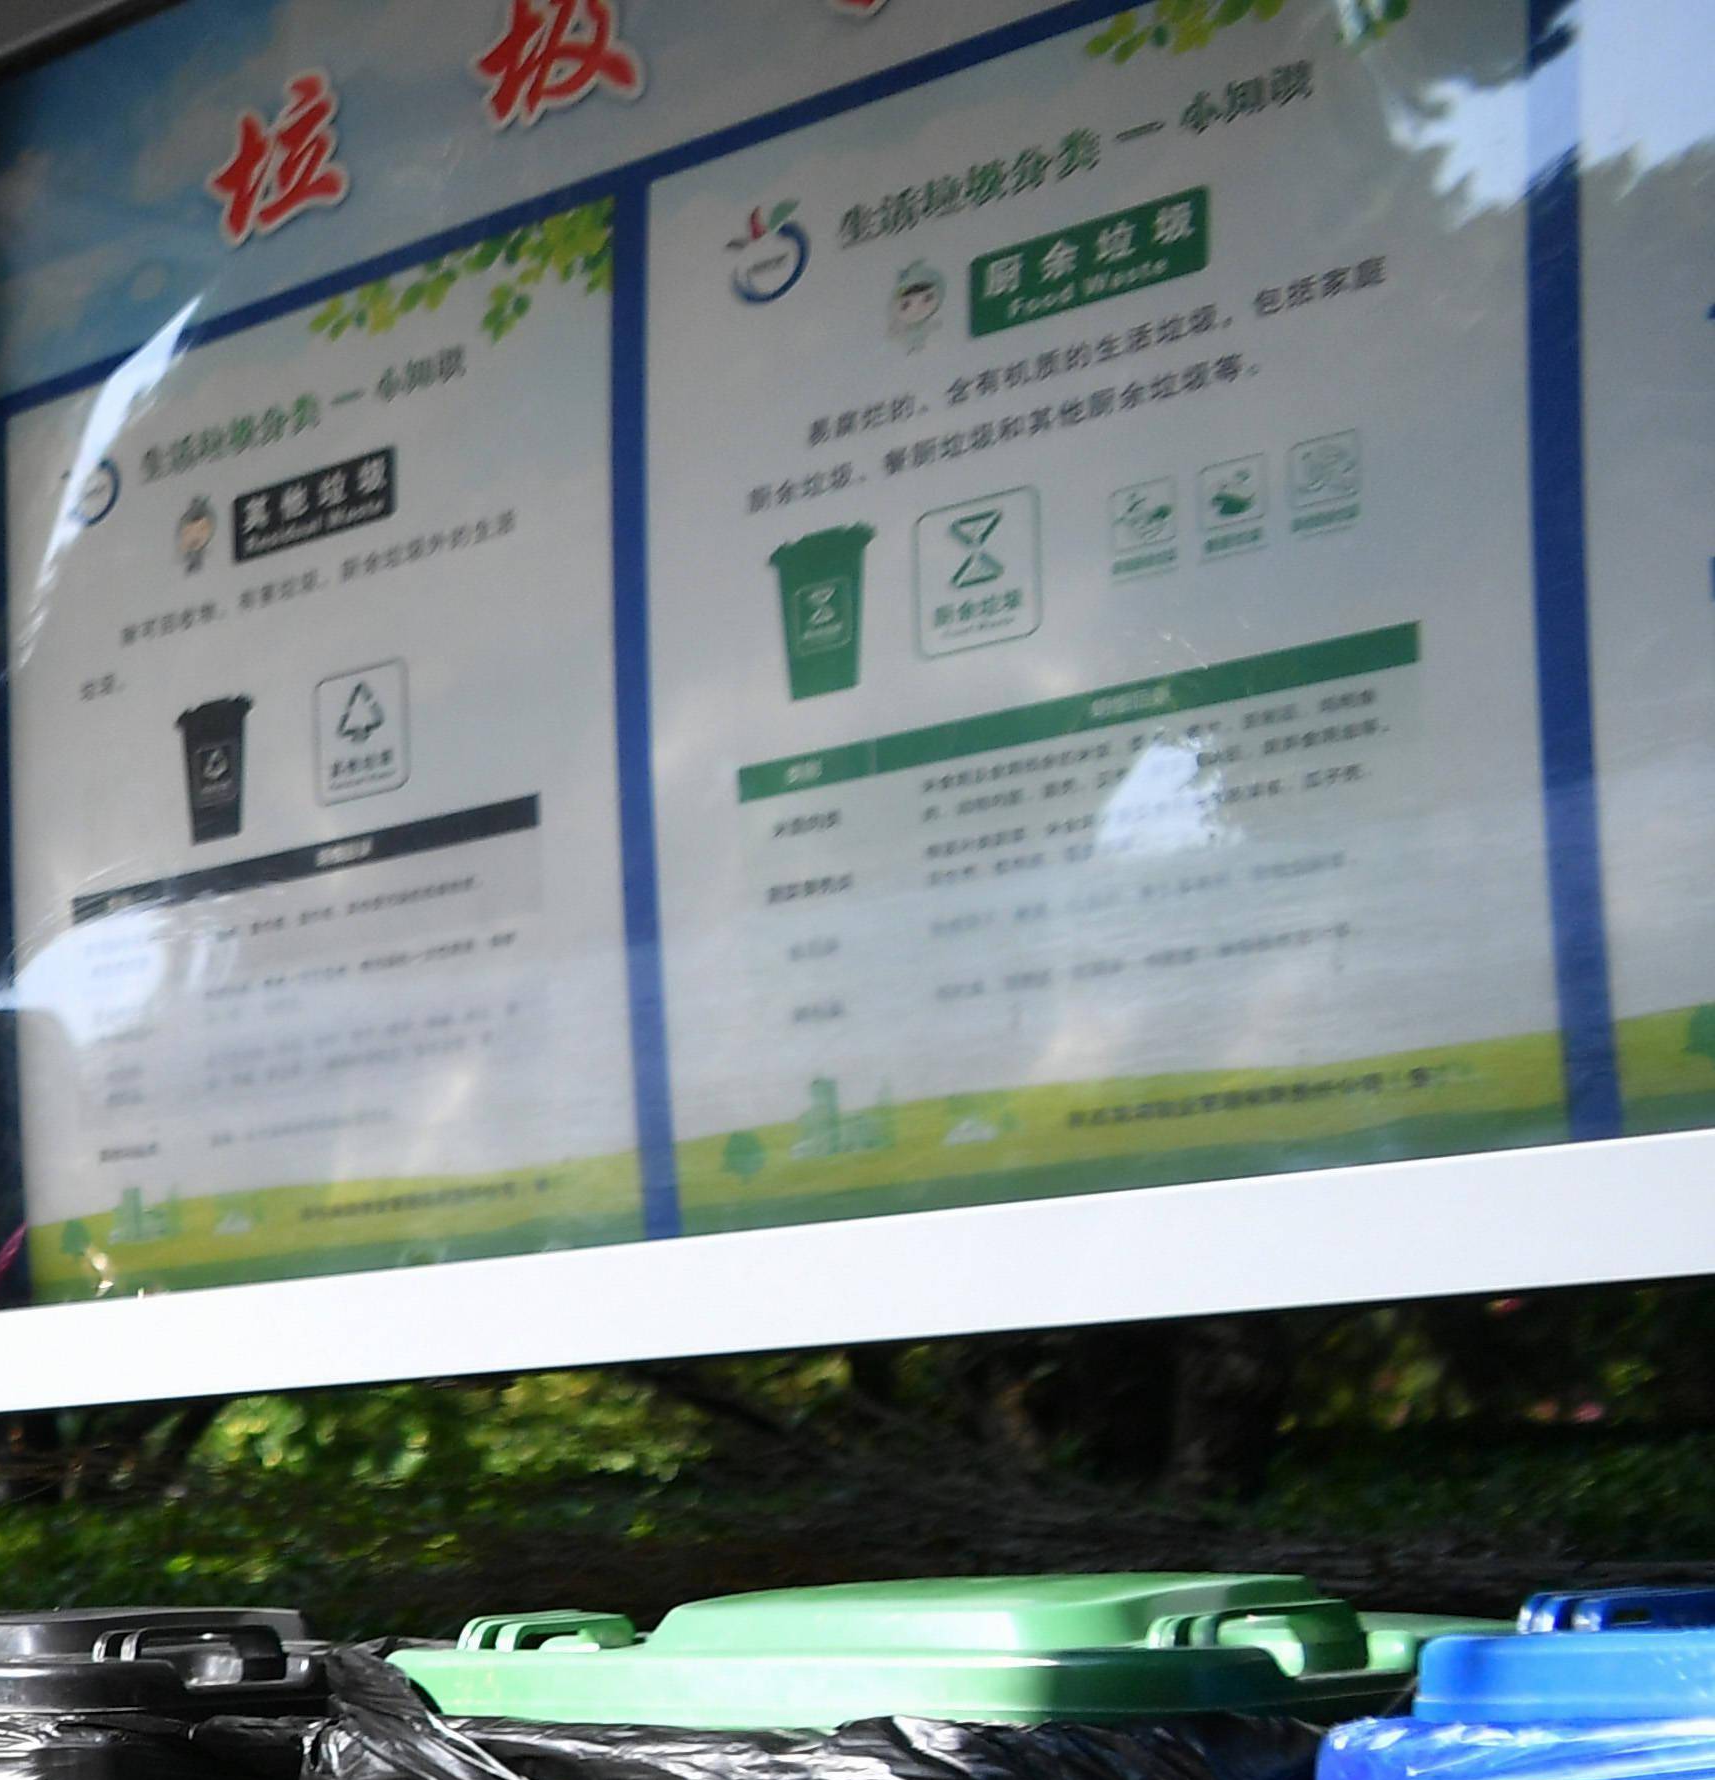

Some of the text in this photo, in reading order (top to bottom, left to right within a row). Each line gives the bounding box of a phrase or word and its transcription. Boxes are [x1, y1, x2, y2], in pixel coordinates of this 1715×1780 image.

[983, 200, 1196, 299] 厨余垃圾
[1006, 257, 1170, 320] Food Waste
[244, 457, 386, 530] 其他垃圾
